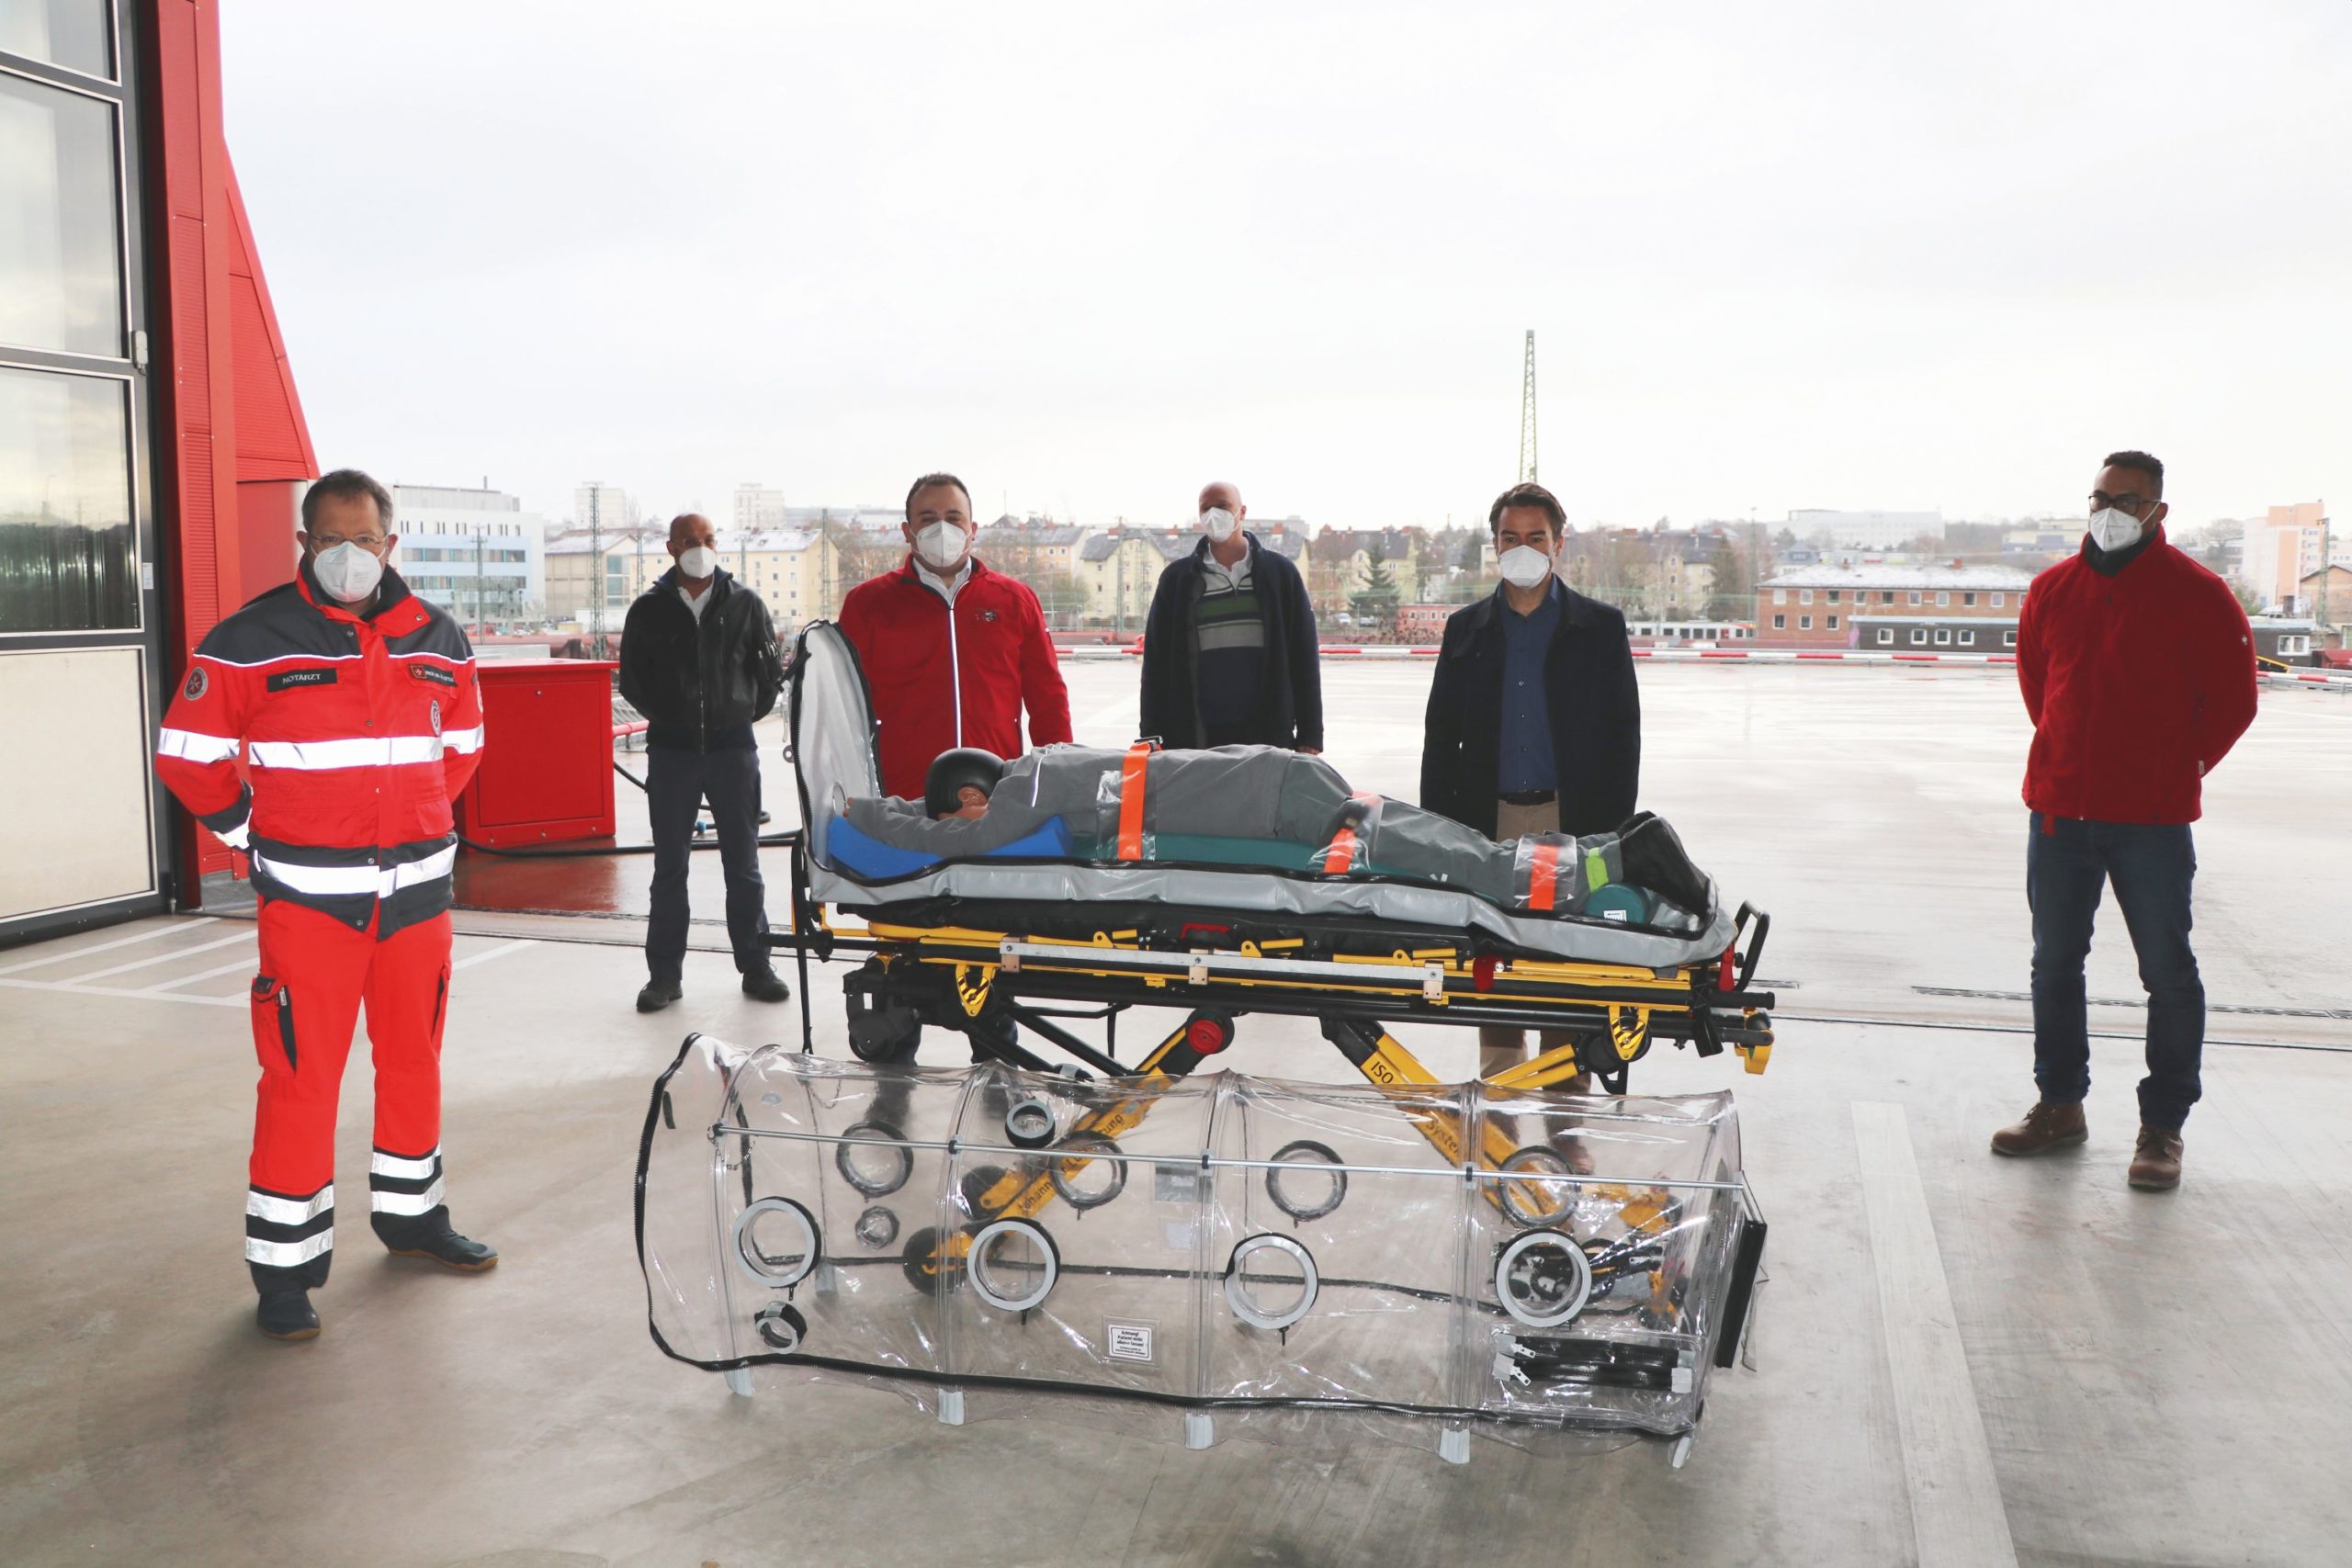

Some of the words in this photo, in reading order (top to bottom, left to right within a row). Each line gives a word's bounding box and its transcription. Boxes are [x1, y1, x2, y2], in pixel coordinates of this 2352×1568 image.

[282, 673, 322, 684] NOTARZT
[1370, 1060, 1395, 1084] ISO
[1426, 1118, 1459, 1155] Syste
